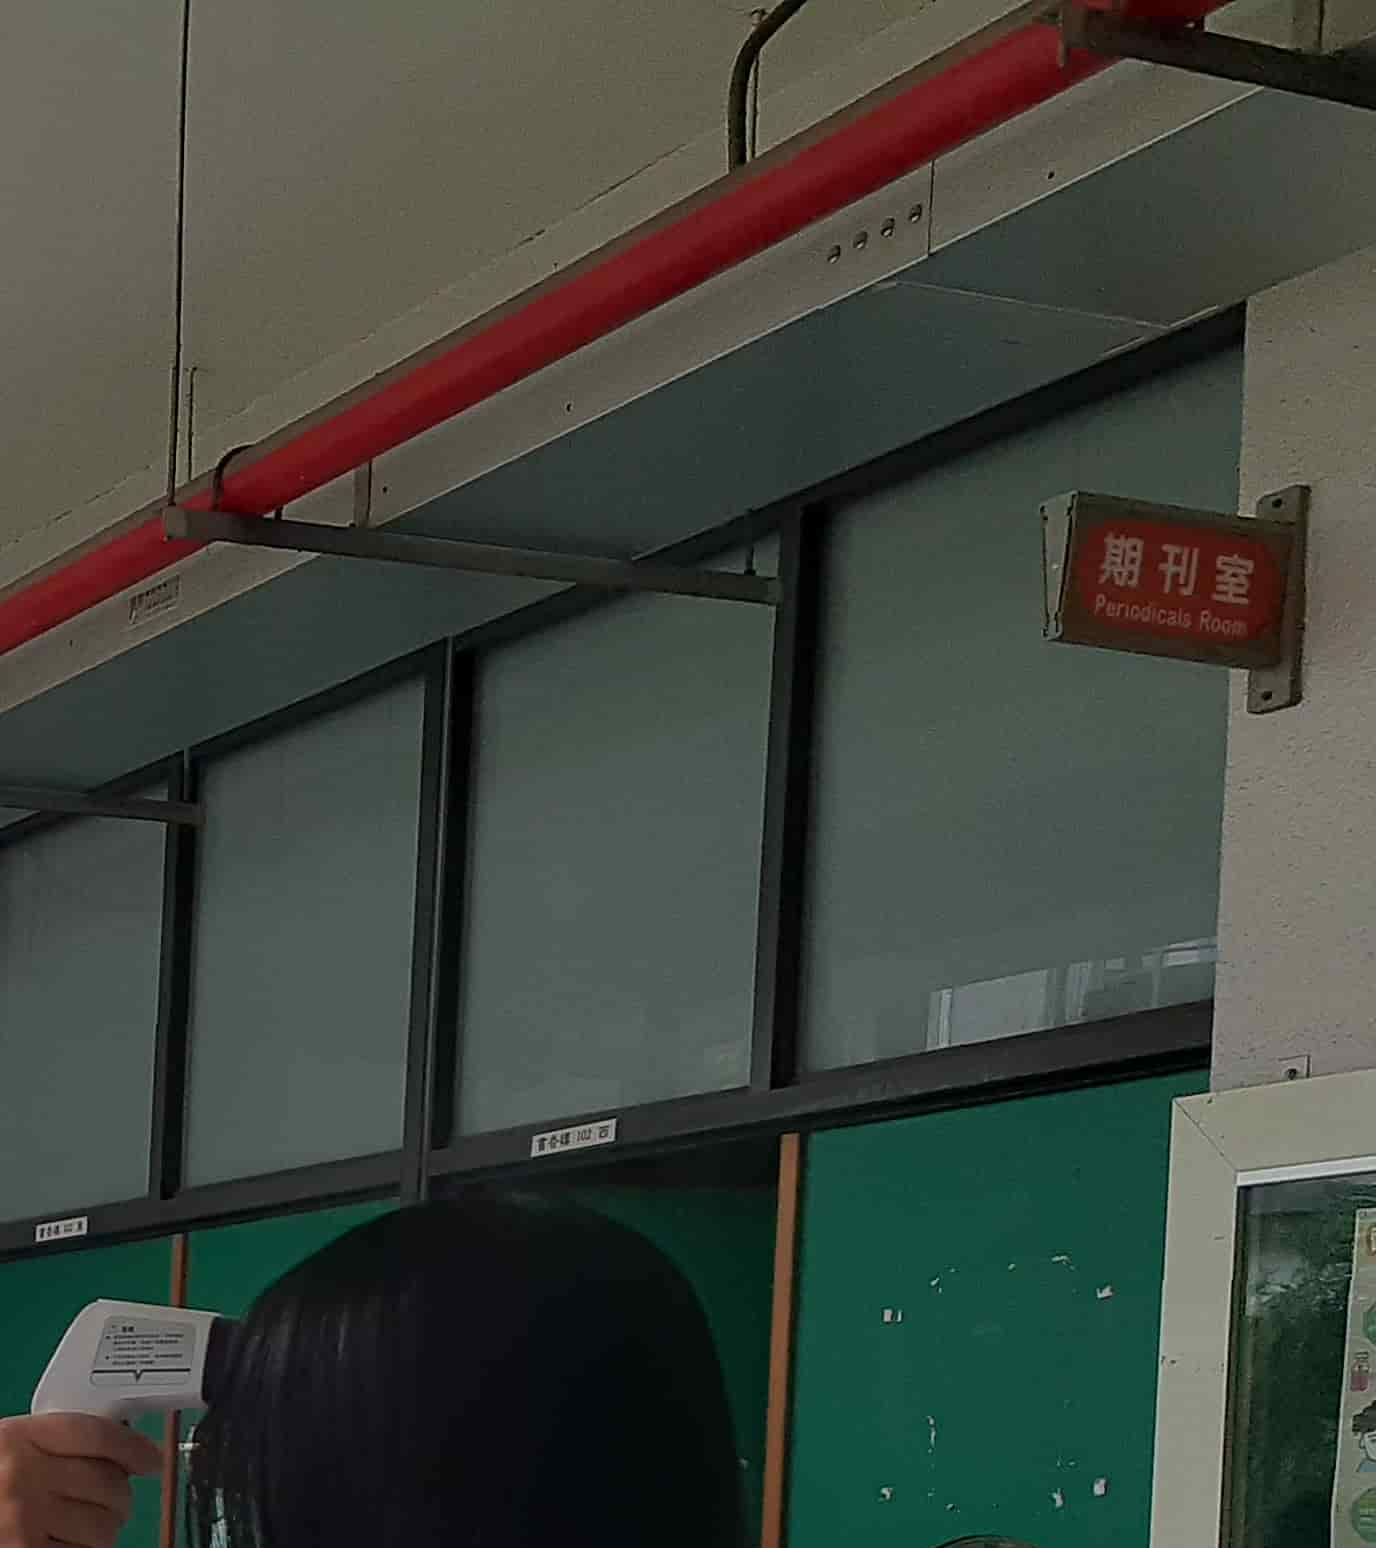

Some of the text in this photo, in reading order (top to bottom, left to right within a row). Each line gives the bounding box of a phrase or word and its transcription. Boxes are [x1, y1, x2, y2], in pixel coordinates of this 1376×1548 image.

[1098, 531, 1255, 605] 期刊室
[1094, 593, 1248, 637] Periodicals Room
